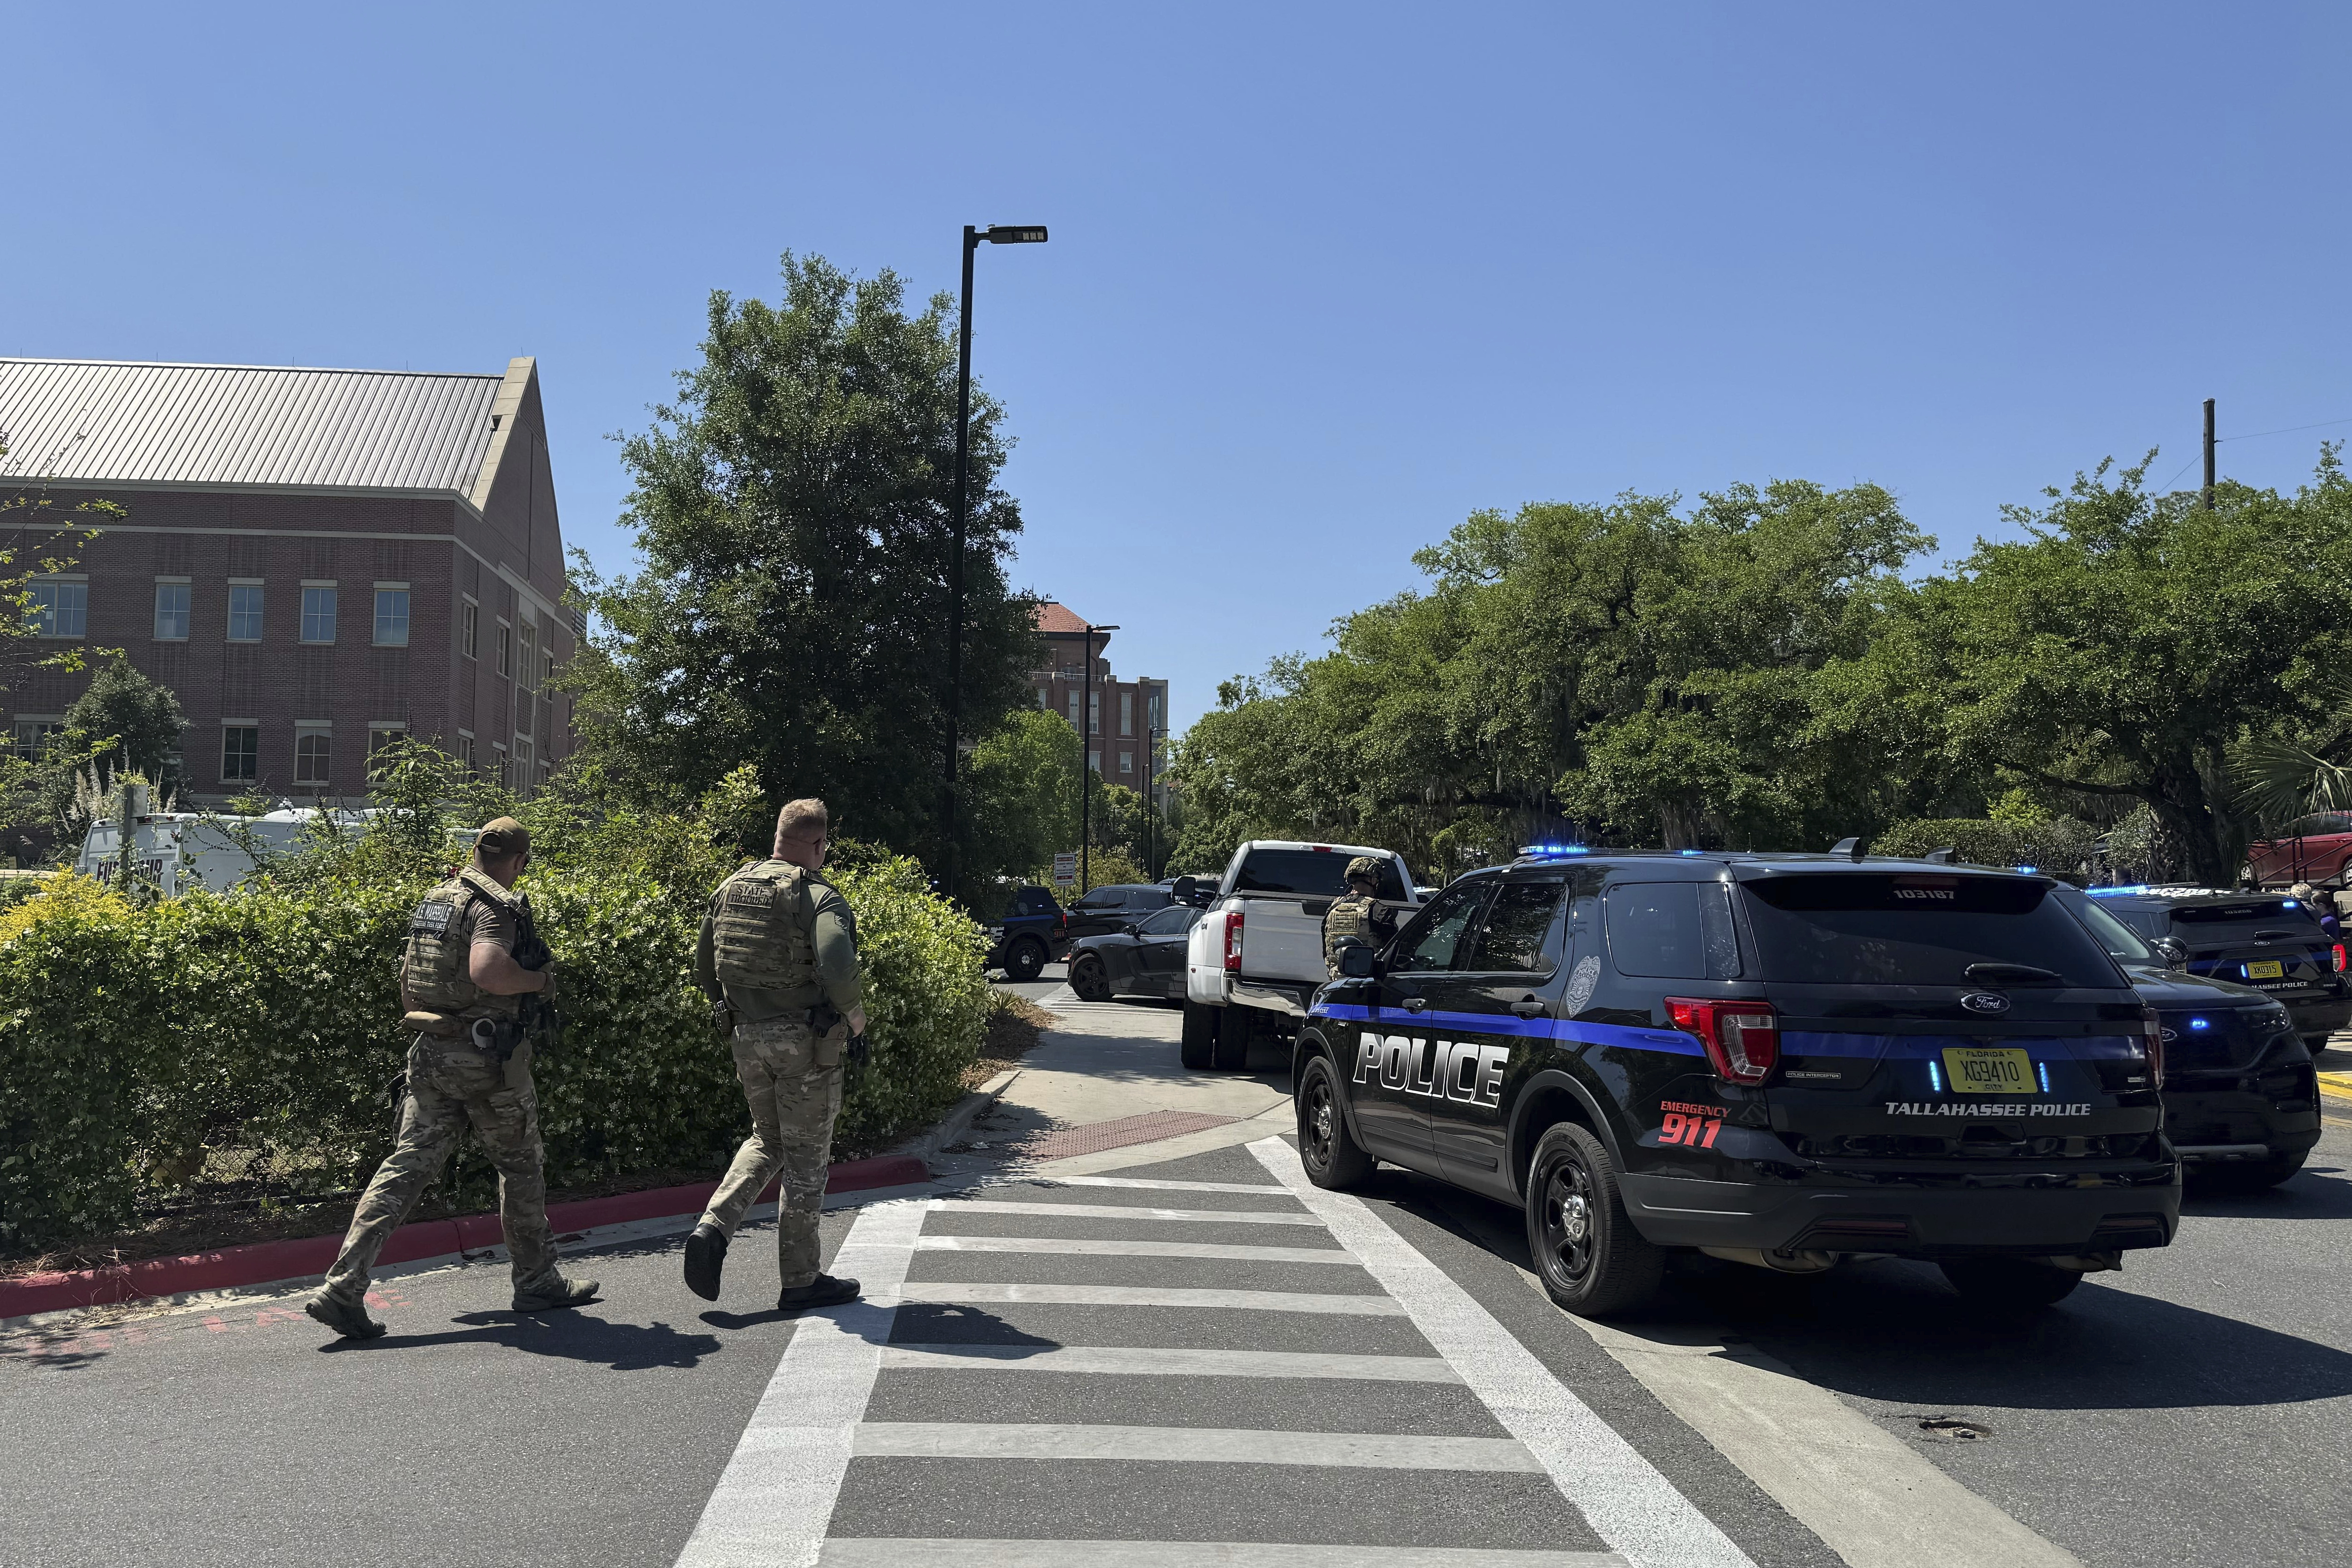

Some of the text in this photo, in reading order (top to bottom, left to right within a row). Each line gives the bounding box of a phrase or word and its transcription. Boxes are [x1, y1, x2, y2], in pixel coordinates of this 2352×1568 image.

[731, 894, 773, 906] TROOPER
[1893, 890, 1954, 899] 103187
[424, 904, 452, 922] MARSHALS
[1975, 996, 2000, 1008] Ford
[1353, 1032, 1510, 1109] POLICE
[1960, 1061, 2020, 1082] XG9410
[1660, 1101, 1732, 1118] EMERGENCY
[1885, 1102, 2091, 1116] TALLAHASSEE POLICE
[1658, 1113, 1722, 1149] 911
